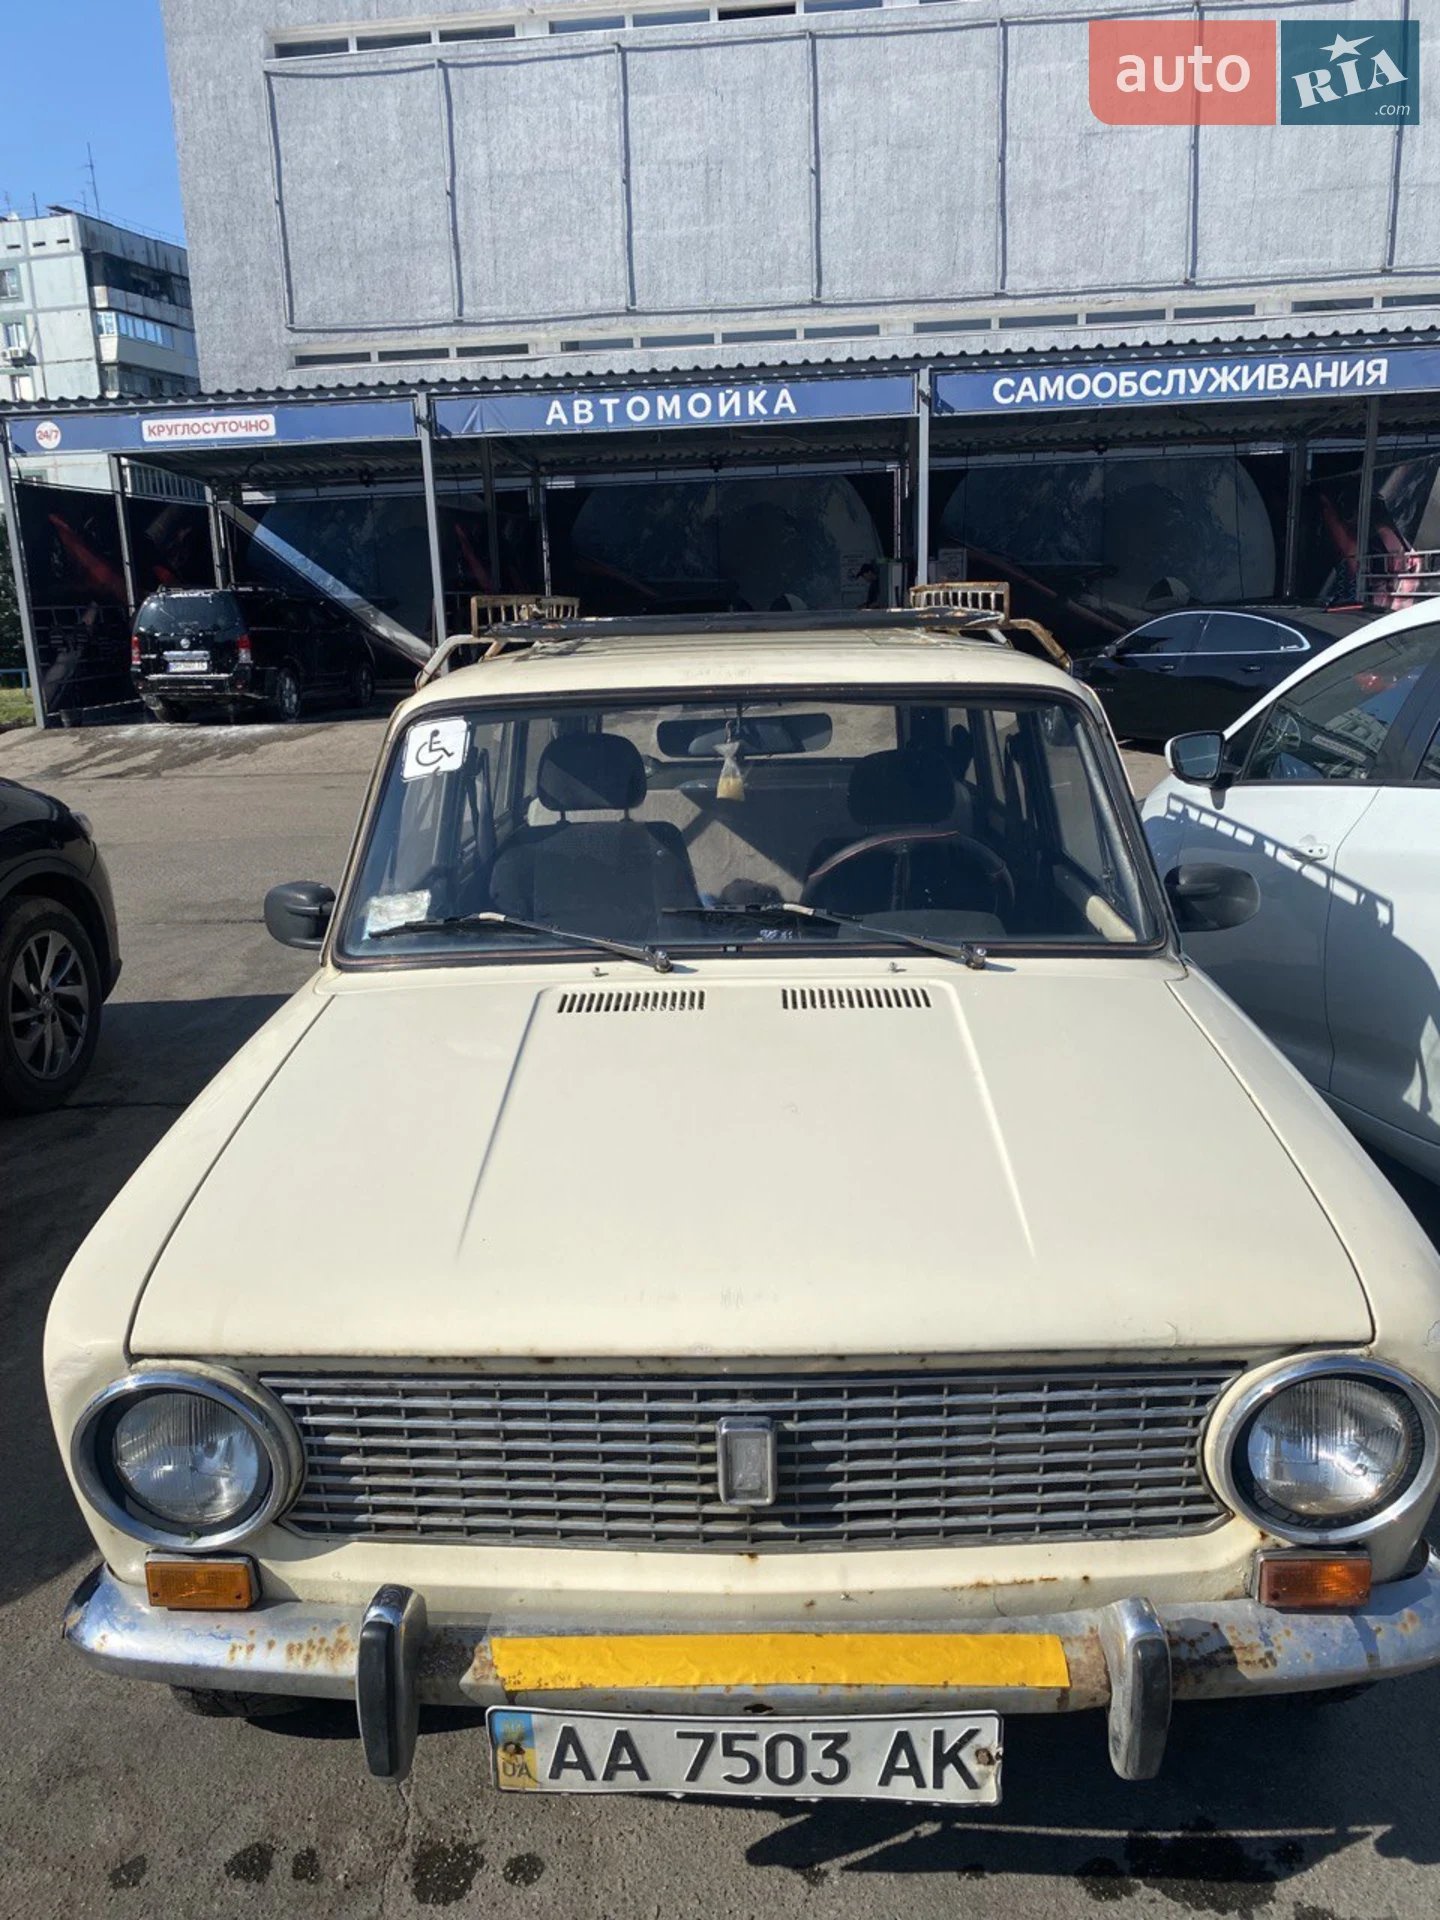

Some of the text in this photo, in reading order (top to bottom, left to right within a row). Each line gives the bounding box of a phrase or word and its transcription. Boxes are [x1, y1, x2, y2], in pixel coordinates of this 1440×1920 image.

[992, 358, 1388, 405] САМООБСЛУЖИВАНИЯ
[545, 388, 797, 426] АВТОМОЙКА
[37, 430, 59, 441] 24/7
[147, 419, 270, 437] КРУГЛОСУТОЧНО
[502, 1761, 532, 1778] UA
[547, 1724, 981, 1790] AA 7503 AK
